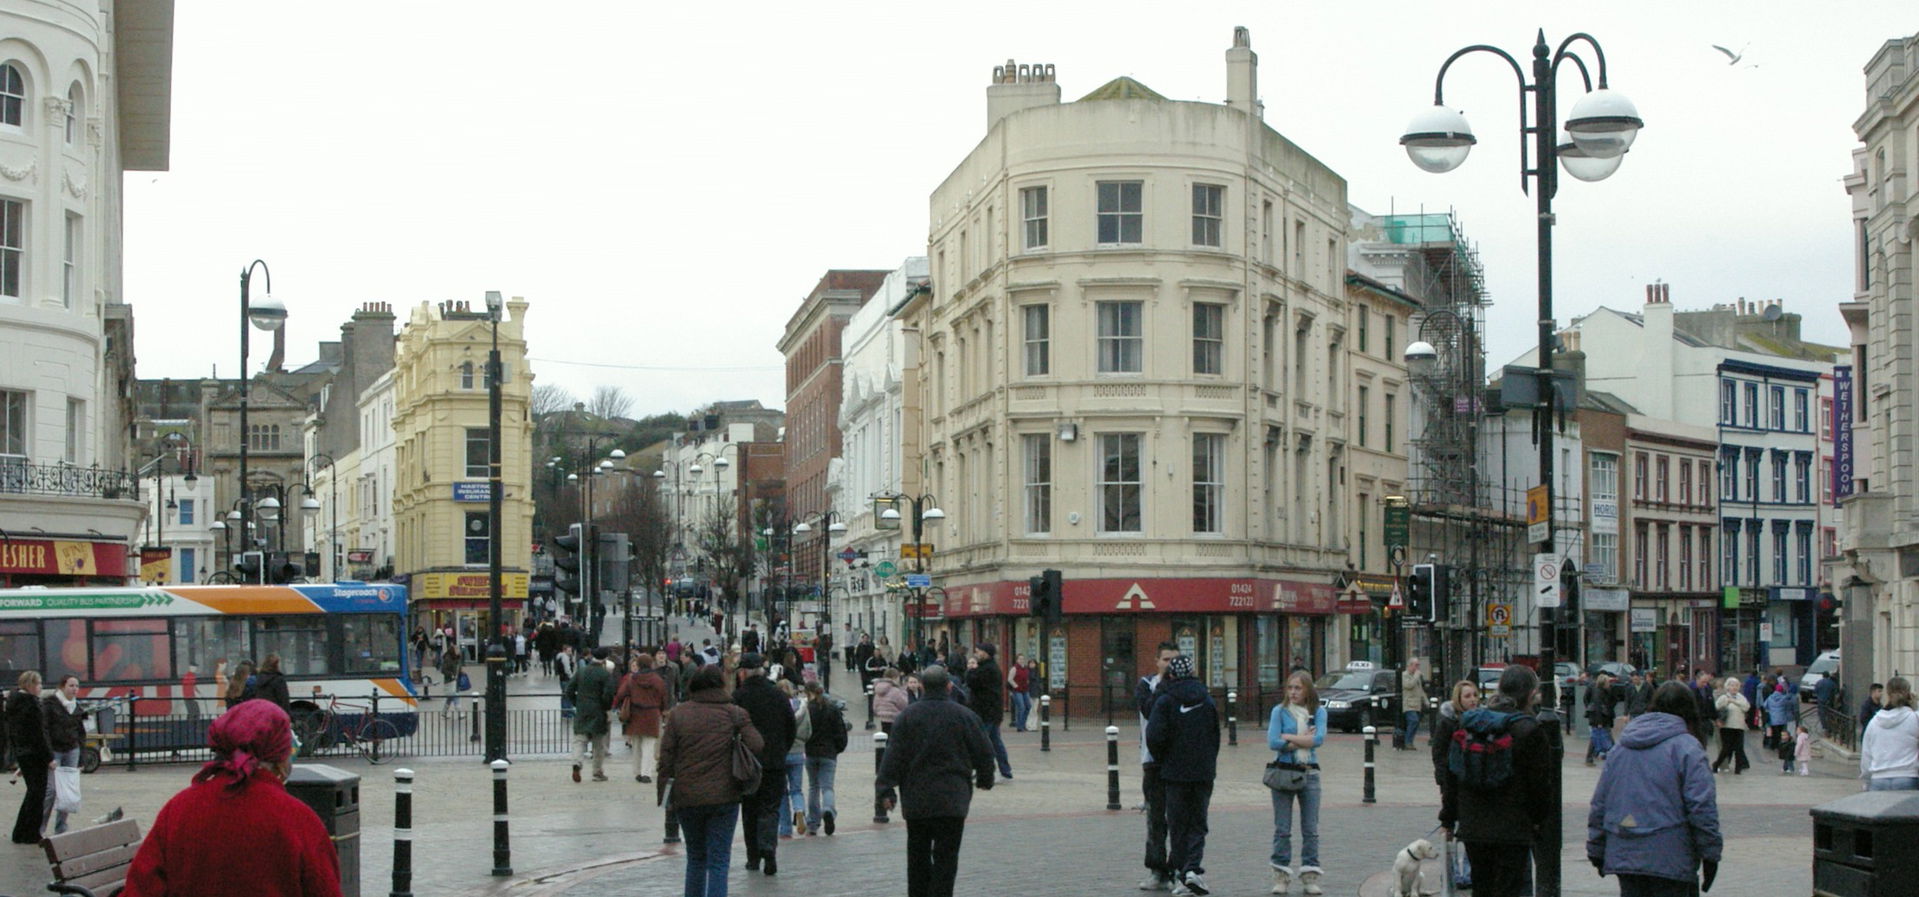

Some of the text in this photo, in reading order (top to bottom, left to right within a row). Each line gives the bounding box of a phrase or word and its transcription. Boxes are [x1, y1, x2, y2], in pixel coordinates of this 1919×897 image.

[1839, 381, 1850, 493] WETHERSPOON
[333, 589, 377, 598] Stagecoach
[1014, 586, 1030, 596] 0142
[46, 598, 78, 607] QUALITY
[80, 598, 94, 606] BUS
[95, 597, 141, 605] PARTNERSHIP
[1013, 599, 1029, 609] 7221
